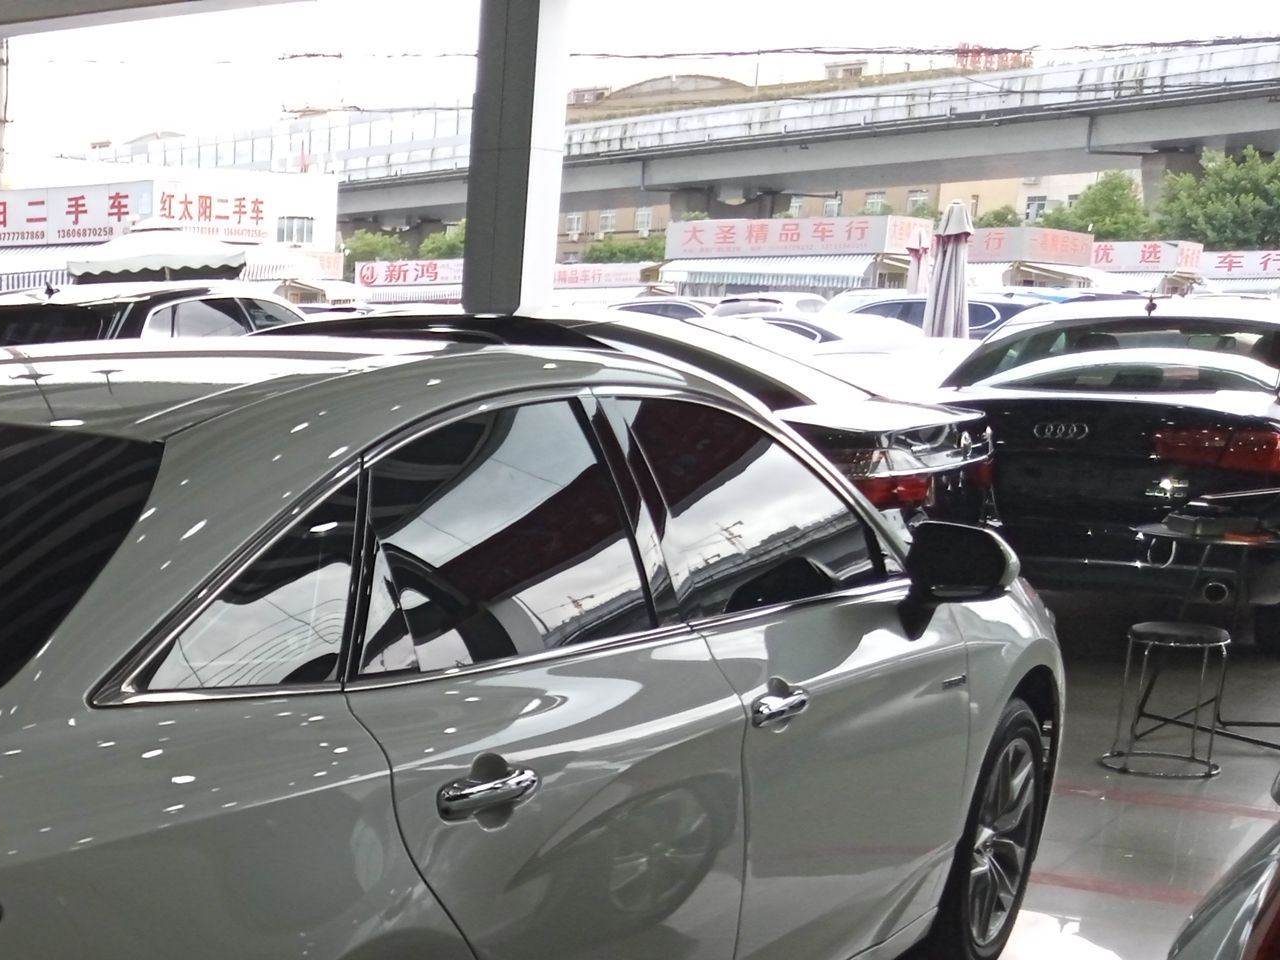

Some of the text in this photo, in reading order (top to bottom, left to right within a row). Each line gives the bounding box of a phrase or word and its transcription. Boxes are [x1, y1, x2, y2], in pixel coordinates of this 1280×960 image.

[159, 191, 265, 226] 红太阳二手车
[682, 220, 870, 246] 大圣精品车行
[554, 269, 603, 285] 精品车行
